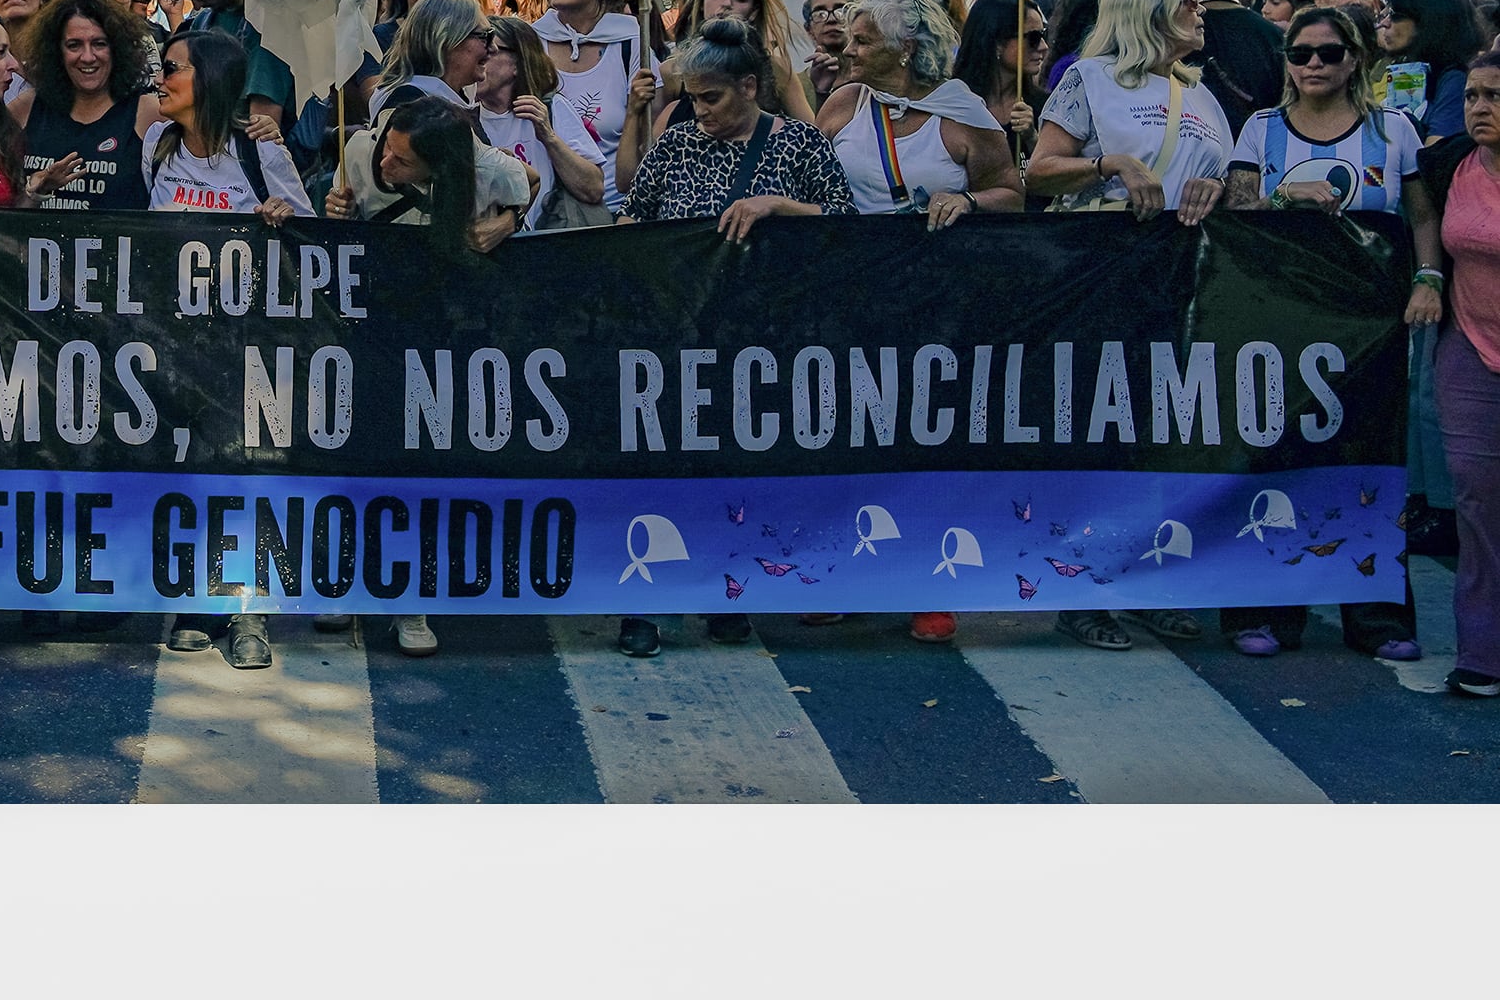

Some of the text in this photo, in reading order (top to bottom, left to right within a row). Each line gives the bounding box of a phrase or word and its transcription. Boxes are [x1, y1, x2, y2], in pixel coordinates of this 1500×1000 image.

[85, 160, 117, 175] TODO
[89, 179, 106, 194] LO
[27, 236, 145, 316] DEL
[175, 239, 368, 319] GOLPE
[243, 345, 355, 450] NO
[404, 347, 569, 453] NOS
[617, 340, 1346, 453] RECONCILIAMOS
[151, 490, 577, 599] GENOCIDIO
